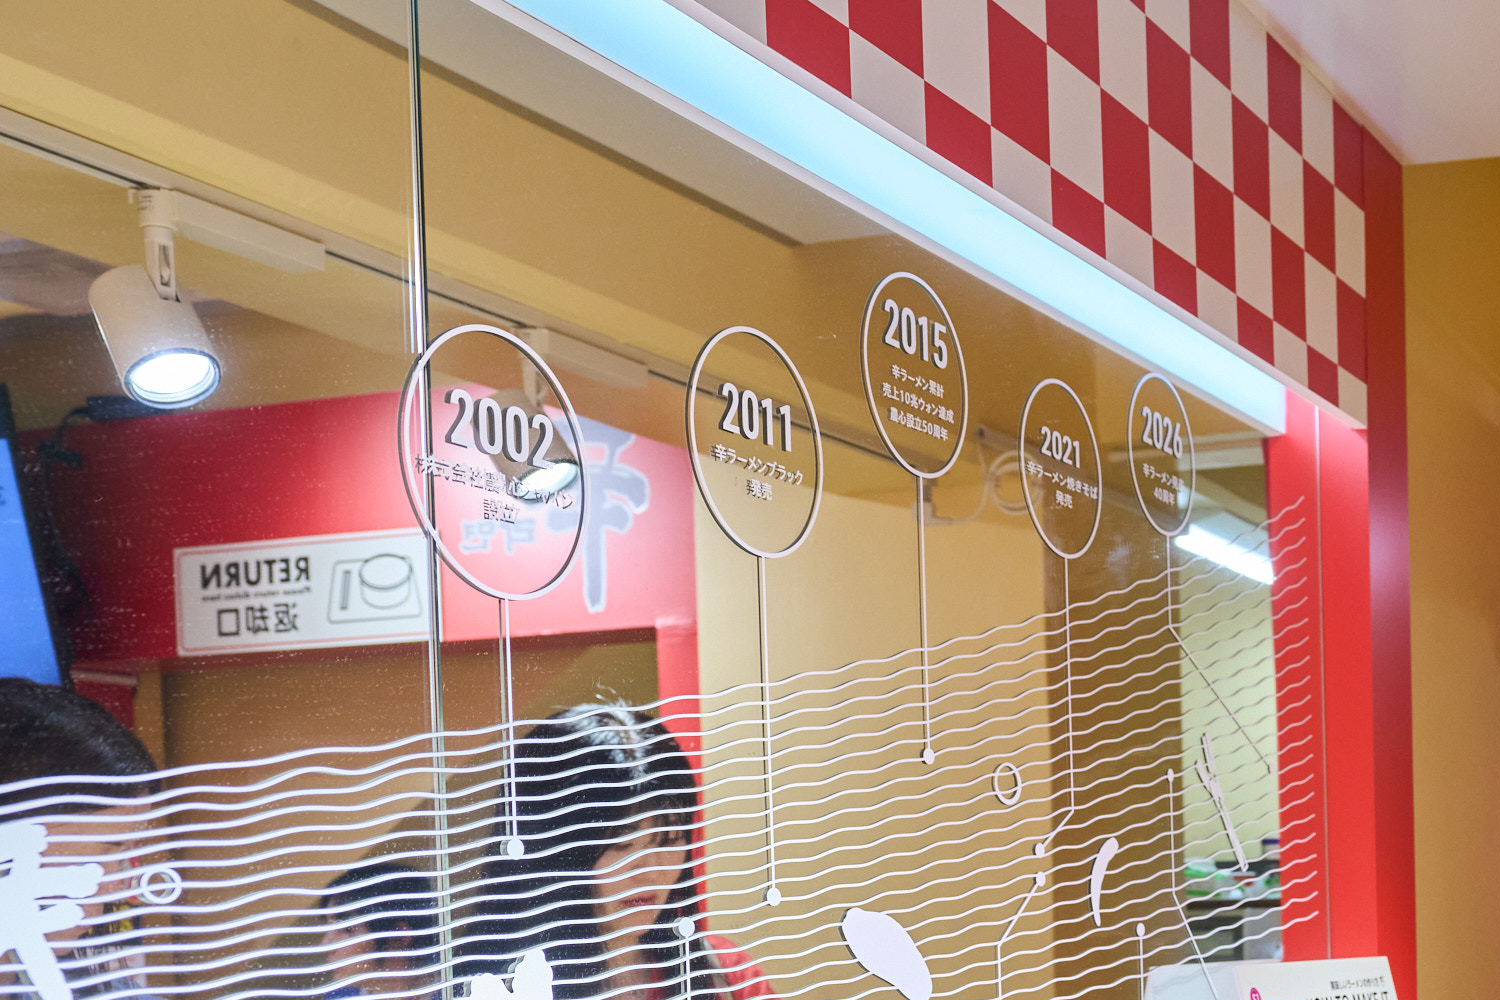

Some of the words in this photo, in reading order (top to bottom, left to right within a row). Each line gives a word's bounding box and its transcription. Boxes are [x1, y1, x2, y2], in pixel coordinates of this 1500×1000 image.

[882, 299, 947, 369] 2015
[890, 364, 944, 399] 辛ラーメン累計
[445, 389, 554, 469] 2002
[718, 382, 792, 452] 2011
[1141, 406, 1183, 459] 2026
[711, 444, 803, 485] 辛ラーメンブラック
[1040, 426, 1080, 469] 2021
[746, 479, 773, 500] 発売
